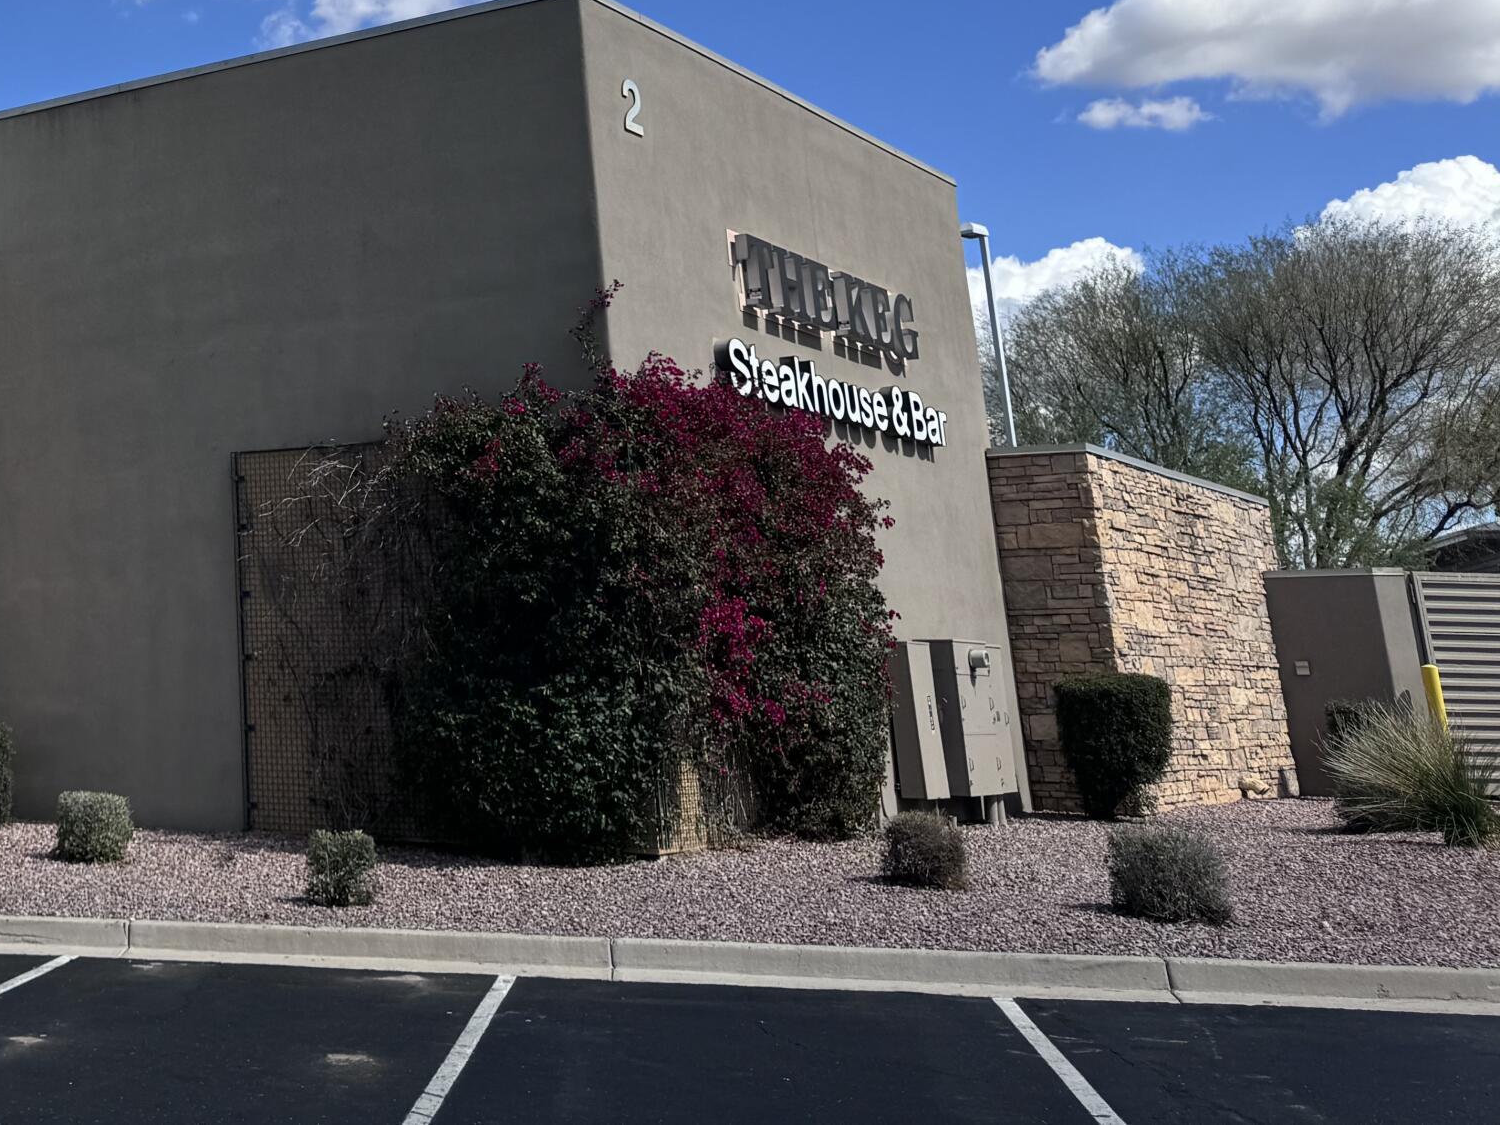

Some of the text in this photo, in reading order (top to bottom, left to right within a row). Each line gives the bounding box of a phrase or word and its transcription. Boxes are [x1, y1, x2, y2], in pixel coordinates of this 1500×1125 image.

[621, 78, 644, 138] 2
[735, 234, 919, 361] THE KEG
[728, 338, 947, 447] Steakhouse & Bar
